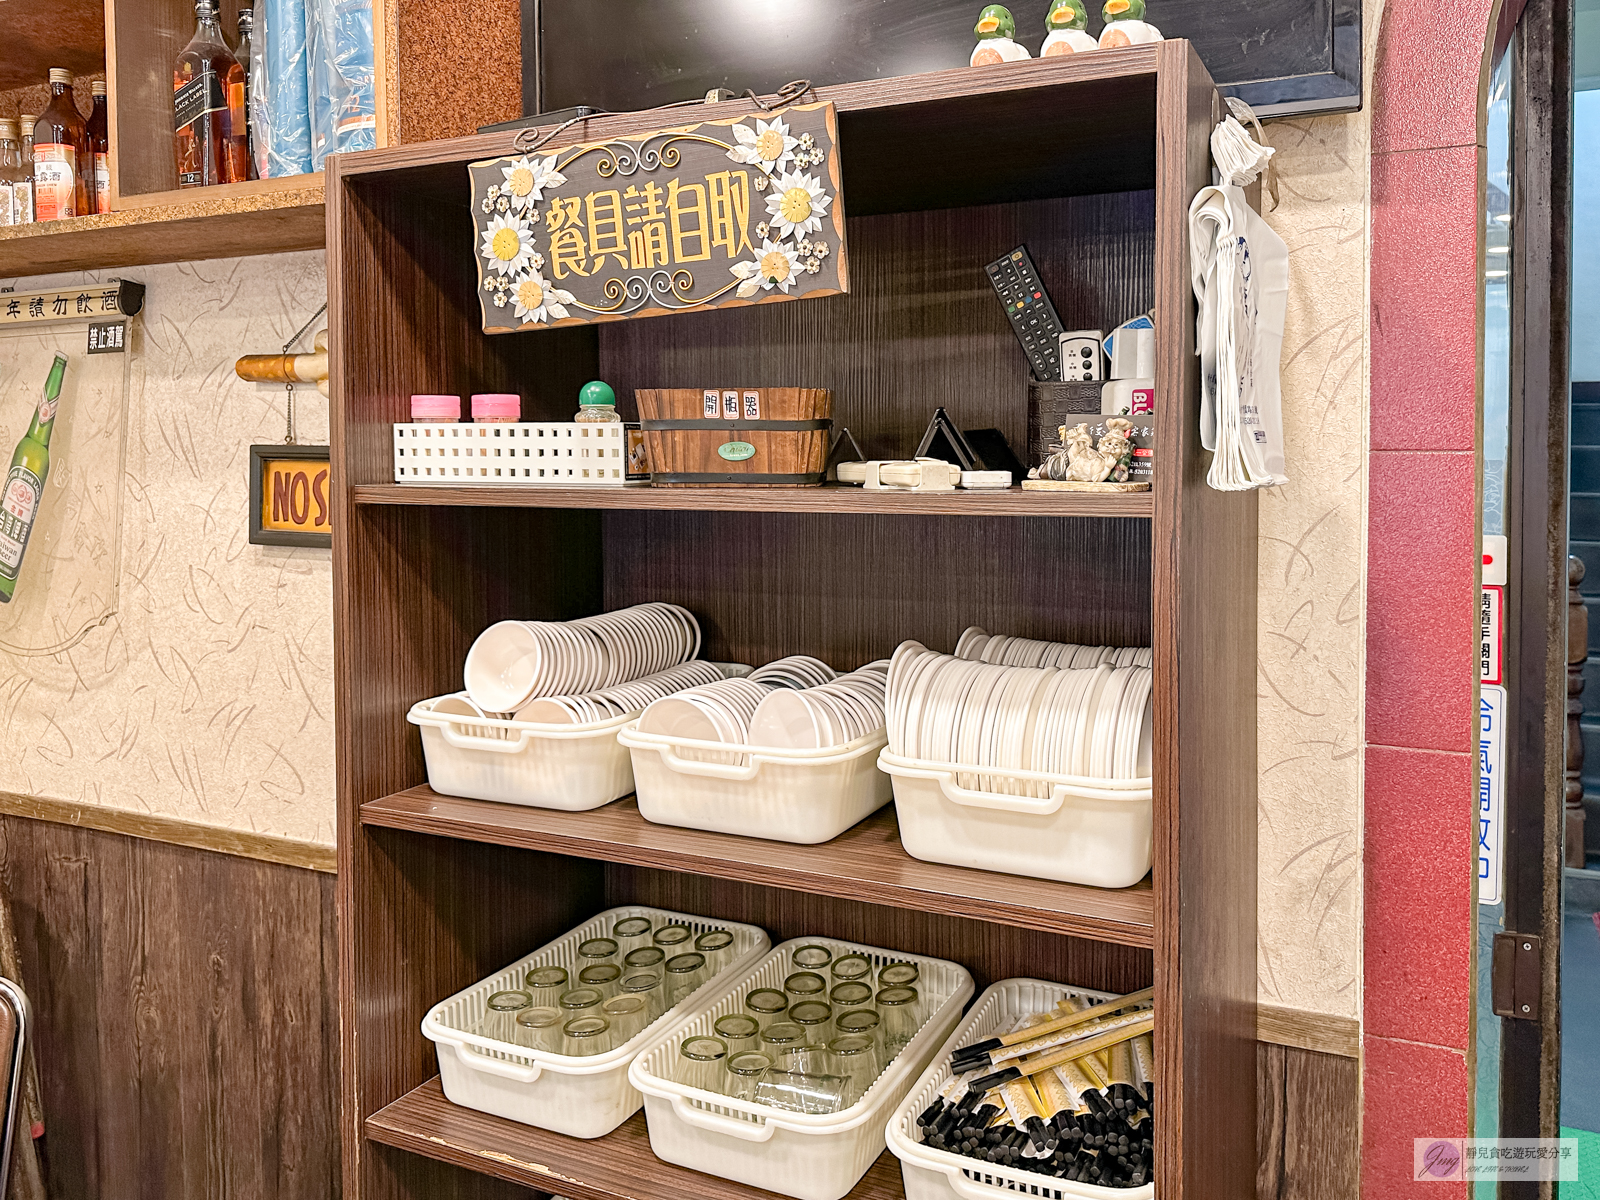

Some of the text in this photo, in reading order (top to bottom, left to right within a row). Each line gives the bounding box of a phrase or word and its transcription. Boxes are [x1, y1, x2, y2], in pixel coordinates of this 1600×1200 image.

[174, 99, 190, 112] LACK
[186, 173, 195, 183] 12
[545, 170, 755, 280] 餐具請自取
[6, 290, 118, 319] 年請勿飲酒
[89, 325, 124, 350] 禁止酒駕
[705, 394, 757, 416] 開瓶器
[312, 468, 332, 528] S
